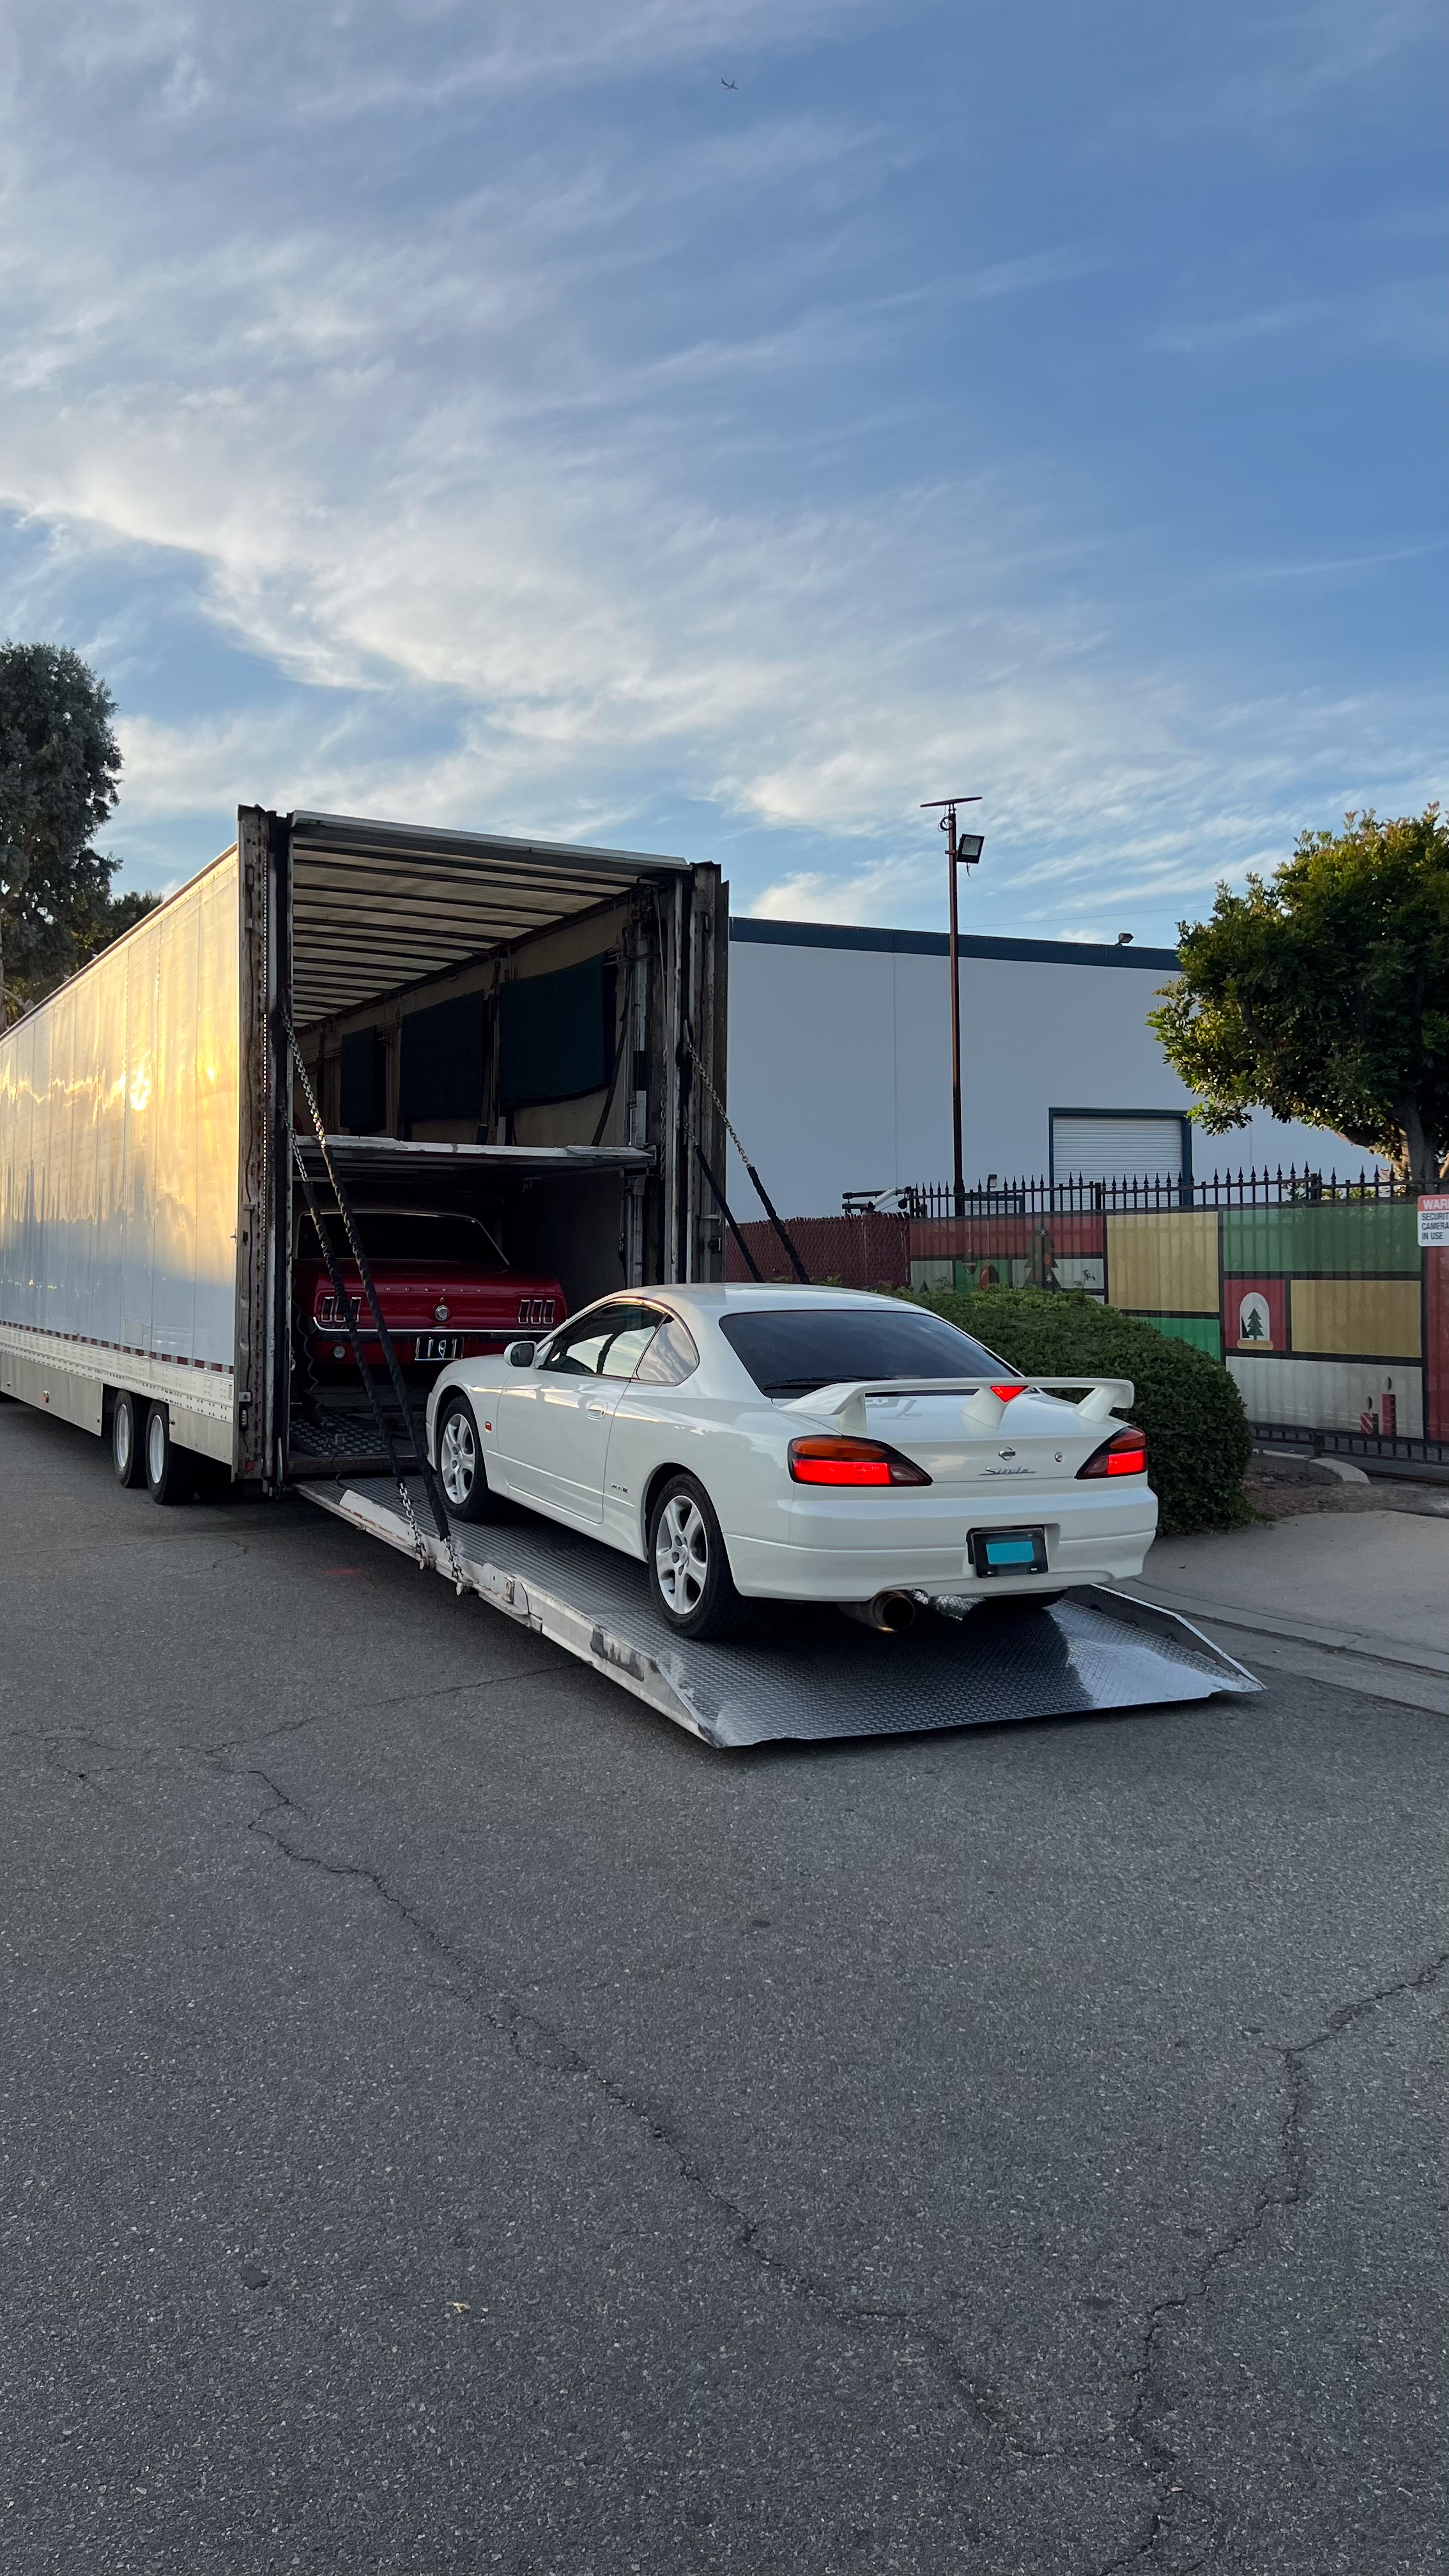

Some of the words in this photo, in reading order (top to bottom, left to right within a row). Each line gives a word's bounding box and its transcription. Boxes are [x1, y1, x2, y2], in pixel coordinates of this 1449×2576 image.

[1422, 1199, 1449, 1210] WAR
[1430, 1232, 1443, 1240] USE
[980, 1466, 1035, 1476] Silvia
